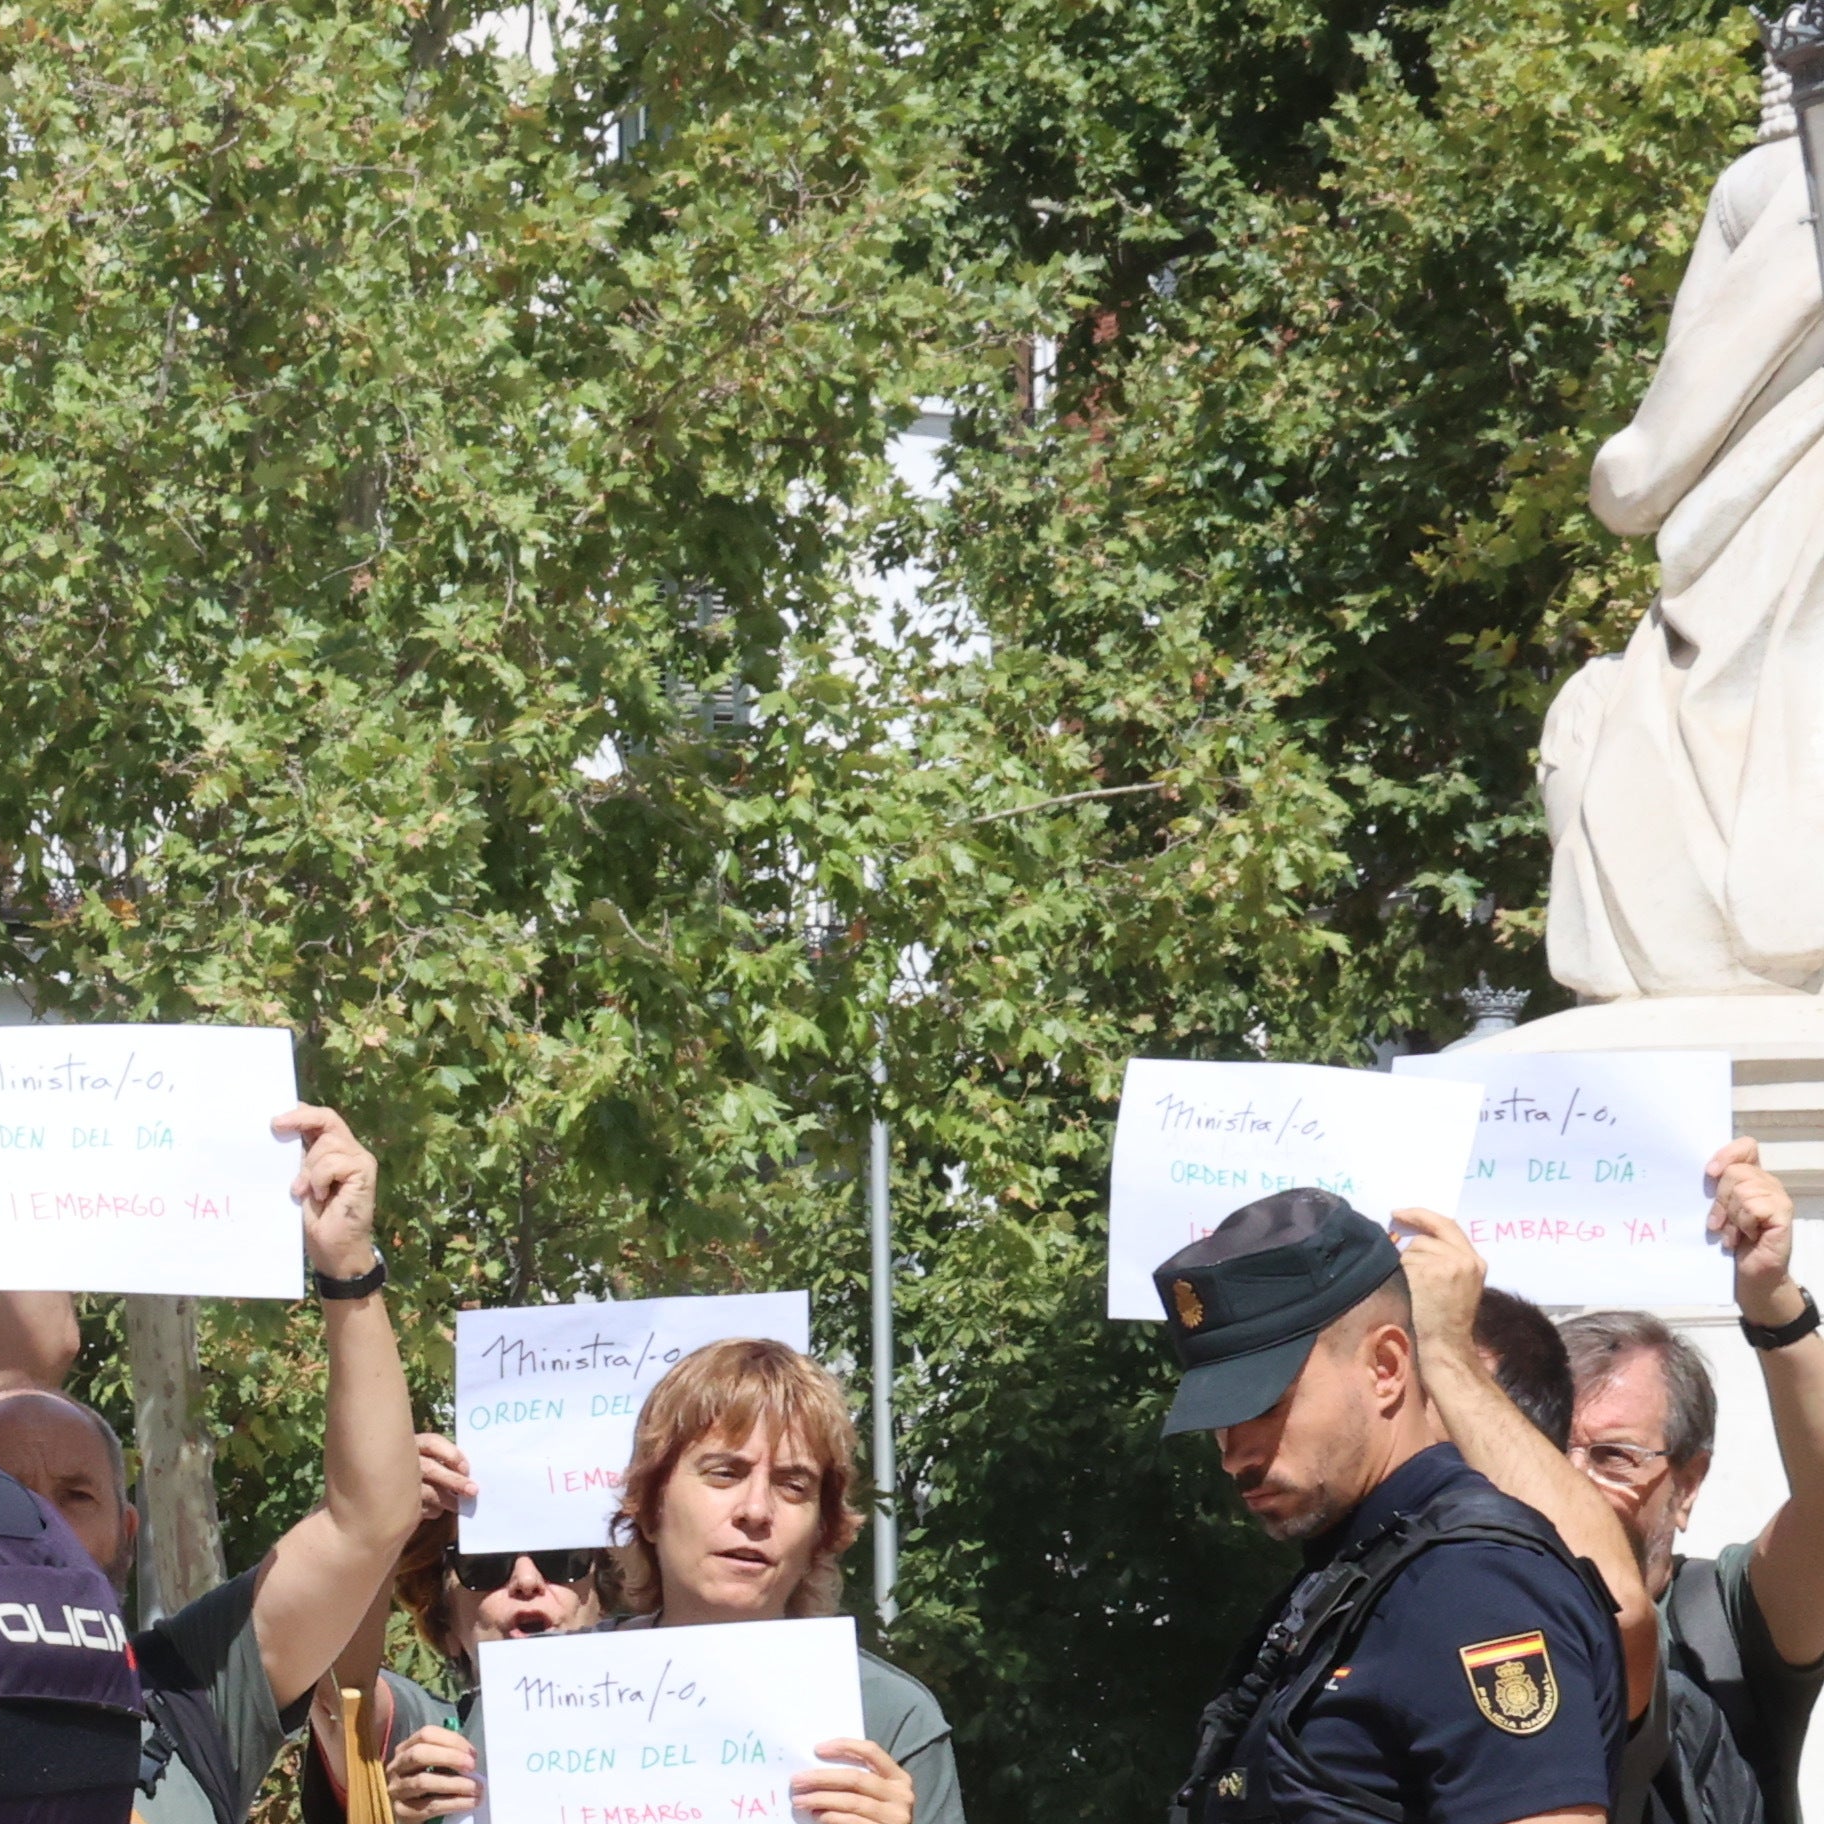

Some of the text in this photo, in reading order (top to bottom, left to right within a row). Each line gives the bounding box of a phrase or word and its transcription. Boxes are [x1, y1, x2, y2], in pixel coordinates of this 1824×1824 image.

[72, 1126, 112, 1149] DEL
[1170, 1159, 1247, 1185] ORDEN
[1527, 1157, 1572, 1182] DEL
[184, 1192, 236, 1222] YA!
[1469, 1216, 1670, 1246] EMBARGO YA!
[469, 1394, 635, 1431] ORDEN DEL
[1520, 1673, 1554, 1729] NACIONAL
[527, 1749, 616, 1773] ORDEN
[641, 1745, 697, 1769] DEL
[730, 1790, 780, 1820] YA!
